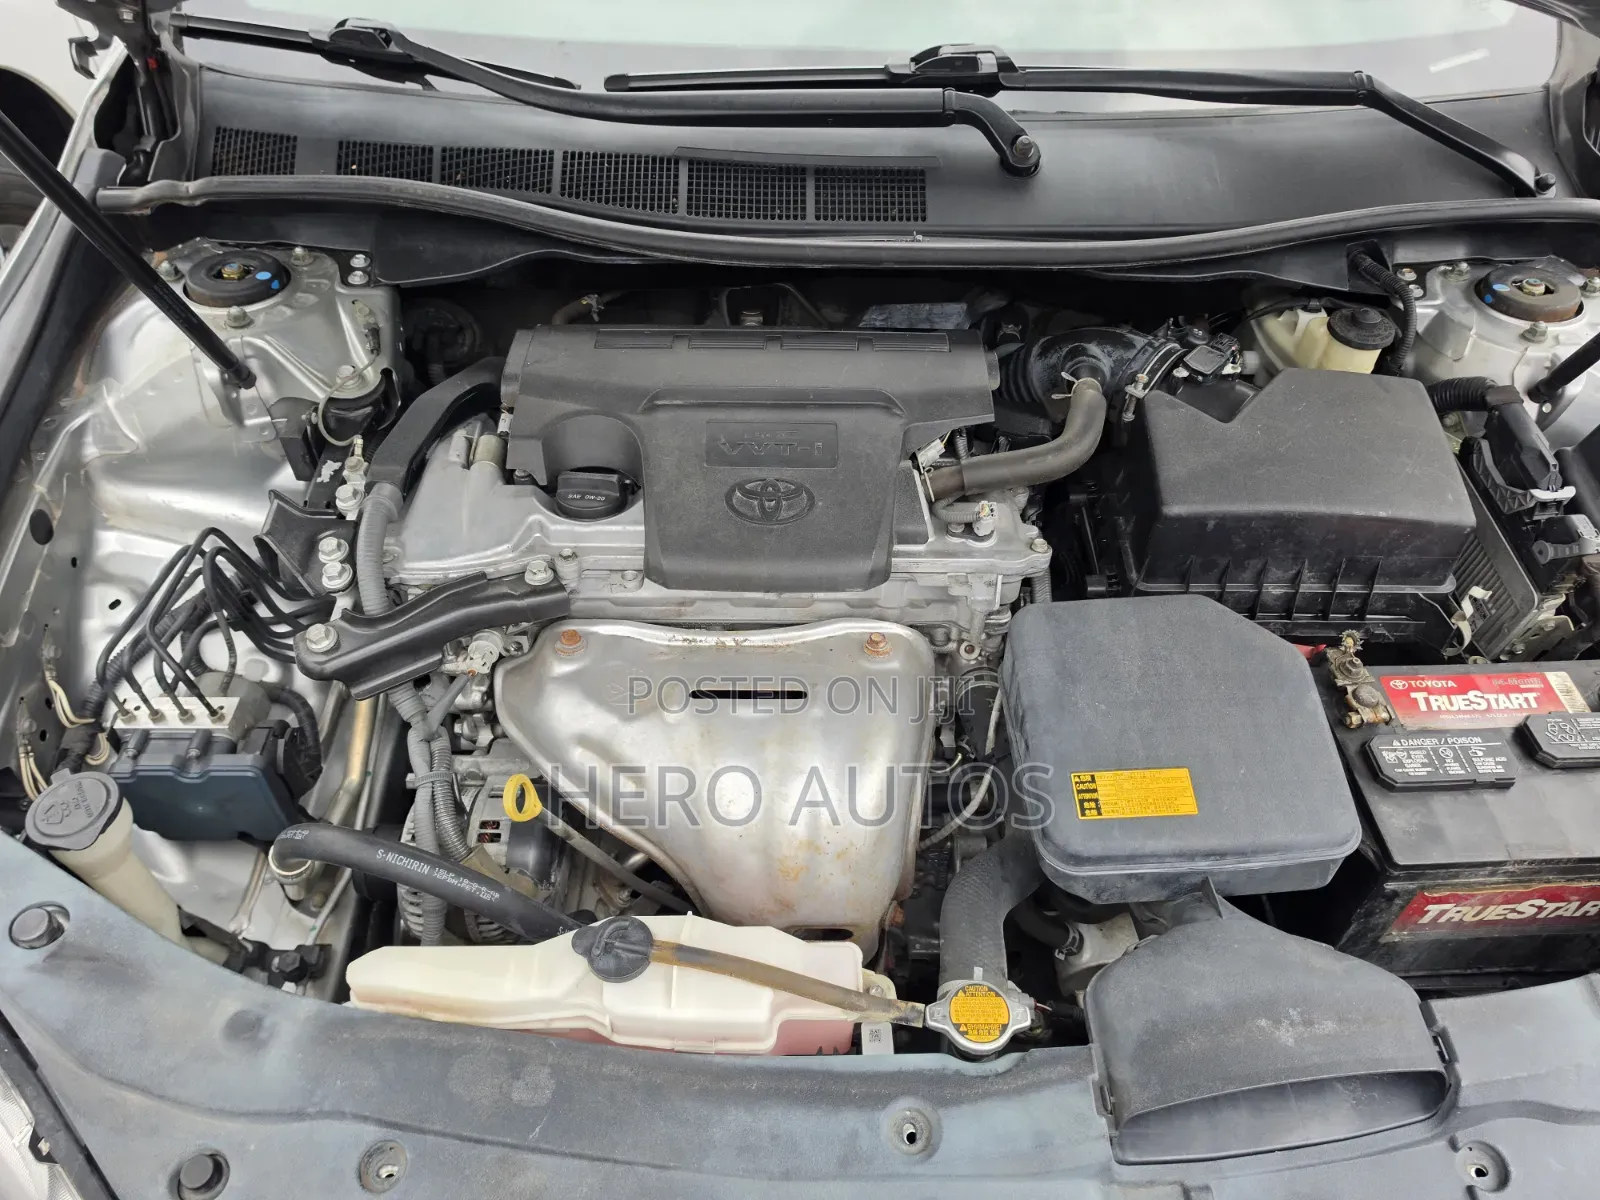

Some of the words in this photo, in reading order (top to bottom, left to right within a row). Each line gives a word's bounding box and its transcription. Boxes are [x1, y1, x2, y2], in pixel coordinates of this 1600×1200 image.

[1408, 680, 1457, 688] TOYOTA
[1400, 738, 1439, 746] DANGER
[1446, 736, 1482, 744] POISON
